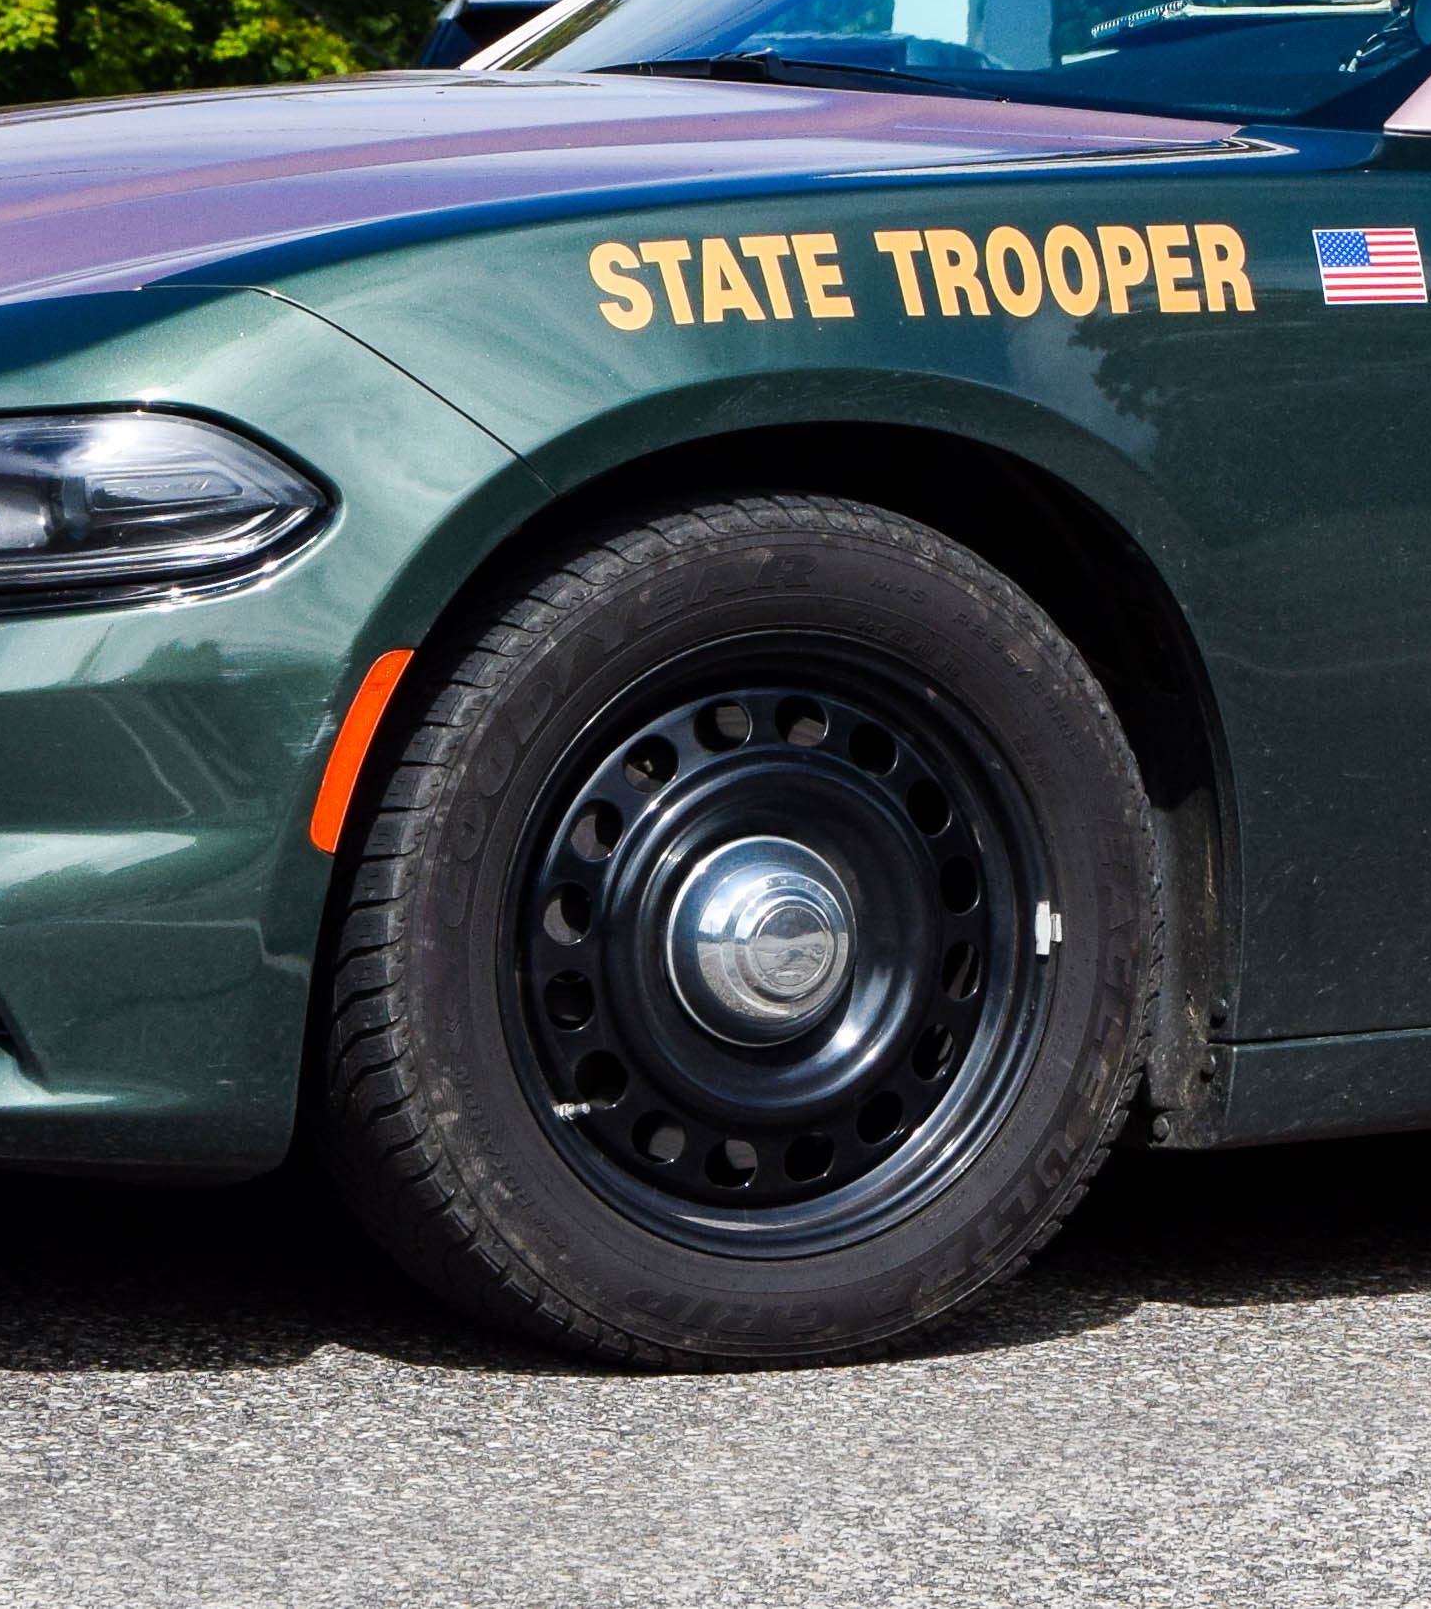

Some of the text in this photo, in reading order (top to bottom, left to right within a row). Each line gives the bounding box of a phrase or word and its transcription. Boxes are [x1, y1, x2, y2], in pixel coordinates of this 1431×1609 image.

[588, 222, 1256, 332] STATE TROOPER
[436, 553, 818, 930] GOODYEAR
